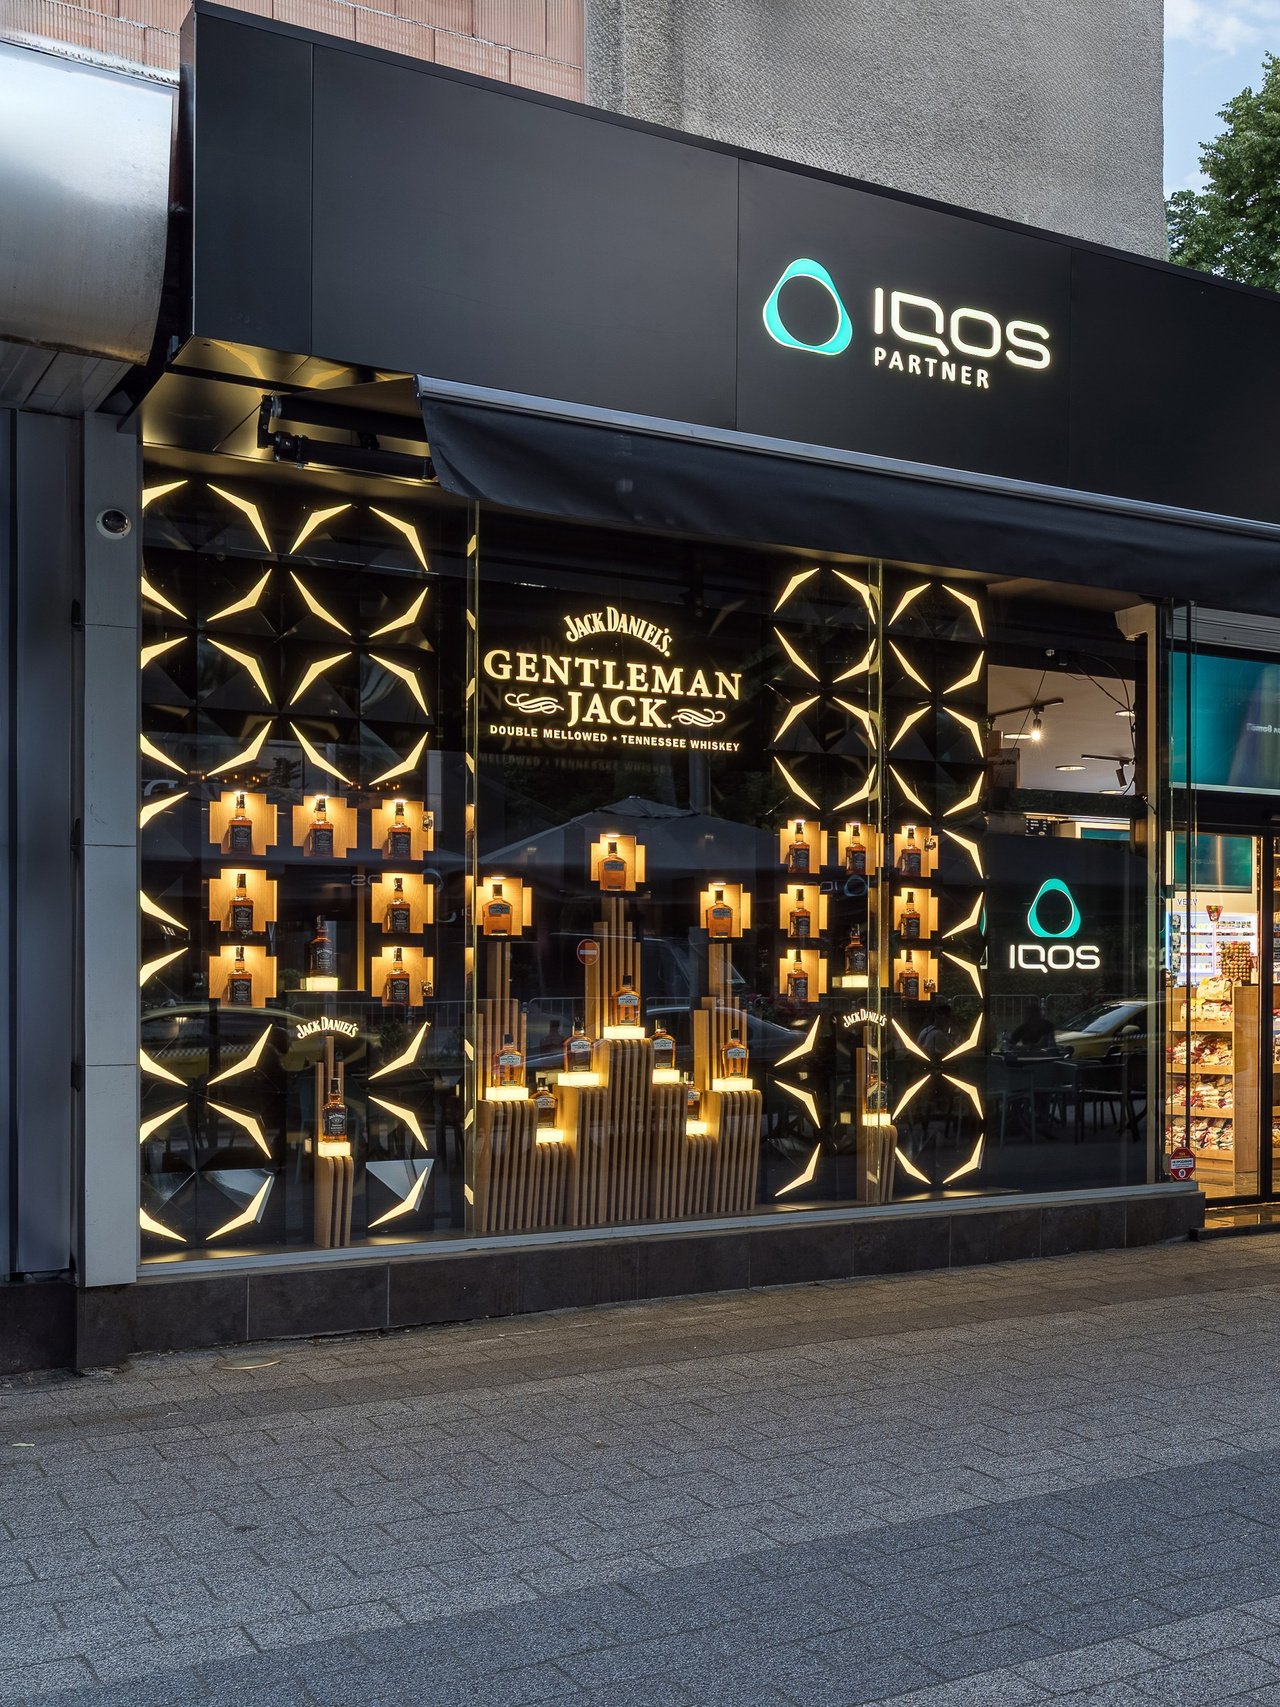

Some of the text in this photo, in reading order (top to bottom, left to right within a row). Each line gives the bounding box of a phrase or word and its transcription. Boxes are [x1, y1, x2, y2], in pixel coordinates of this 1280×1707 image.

[874, 287, 1051, 369] IQOS
[874, 347, 990, 389] PARTNER
[564, 613, 607, 642] JACK
[483, 649, 742, 700] GENTLEMAN
[490, 724, 740, 752] DOUBLE MELLOWED TENNESSEE WHISKEY
[1010, 944, 1100, 973] IQOS
[296, 1016, 359, 1039] JACK DANIEL'S
[843, 1011, 861, 1028] JACK
